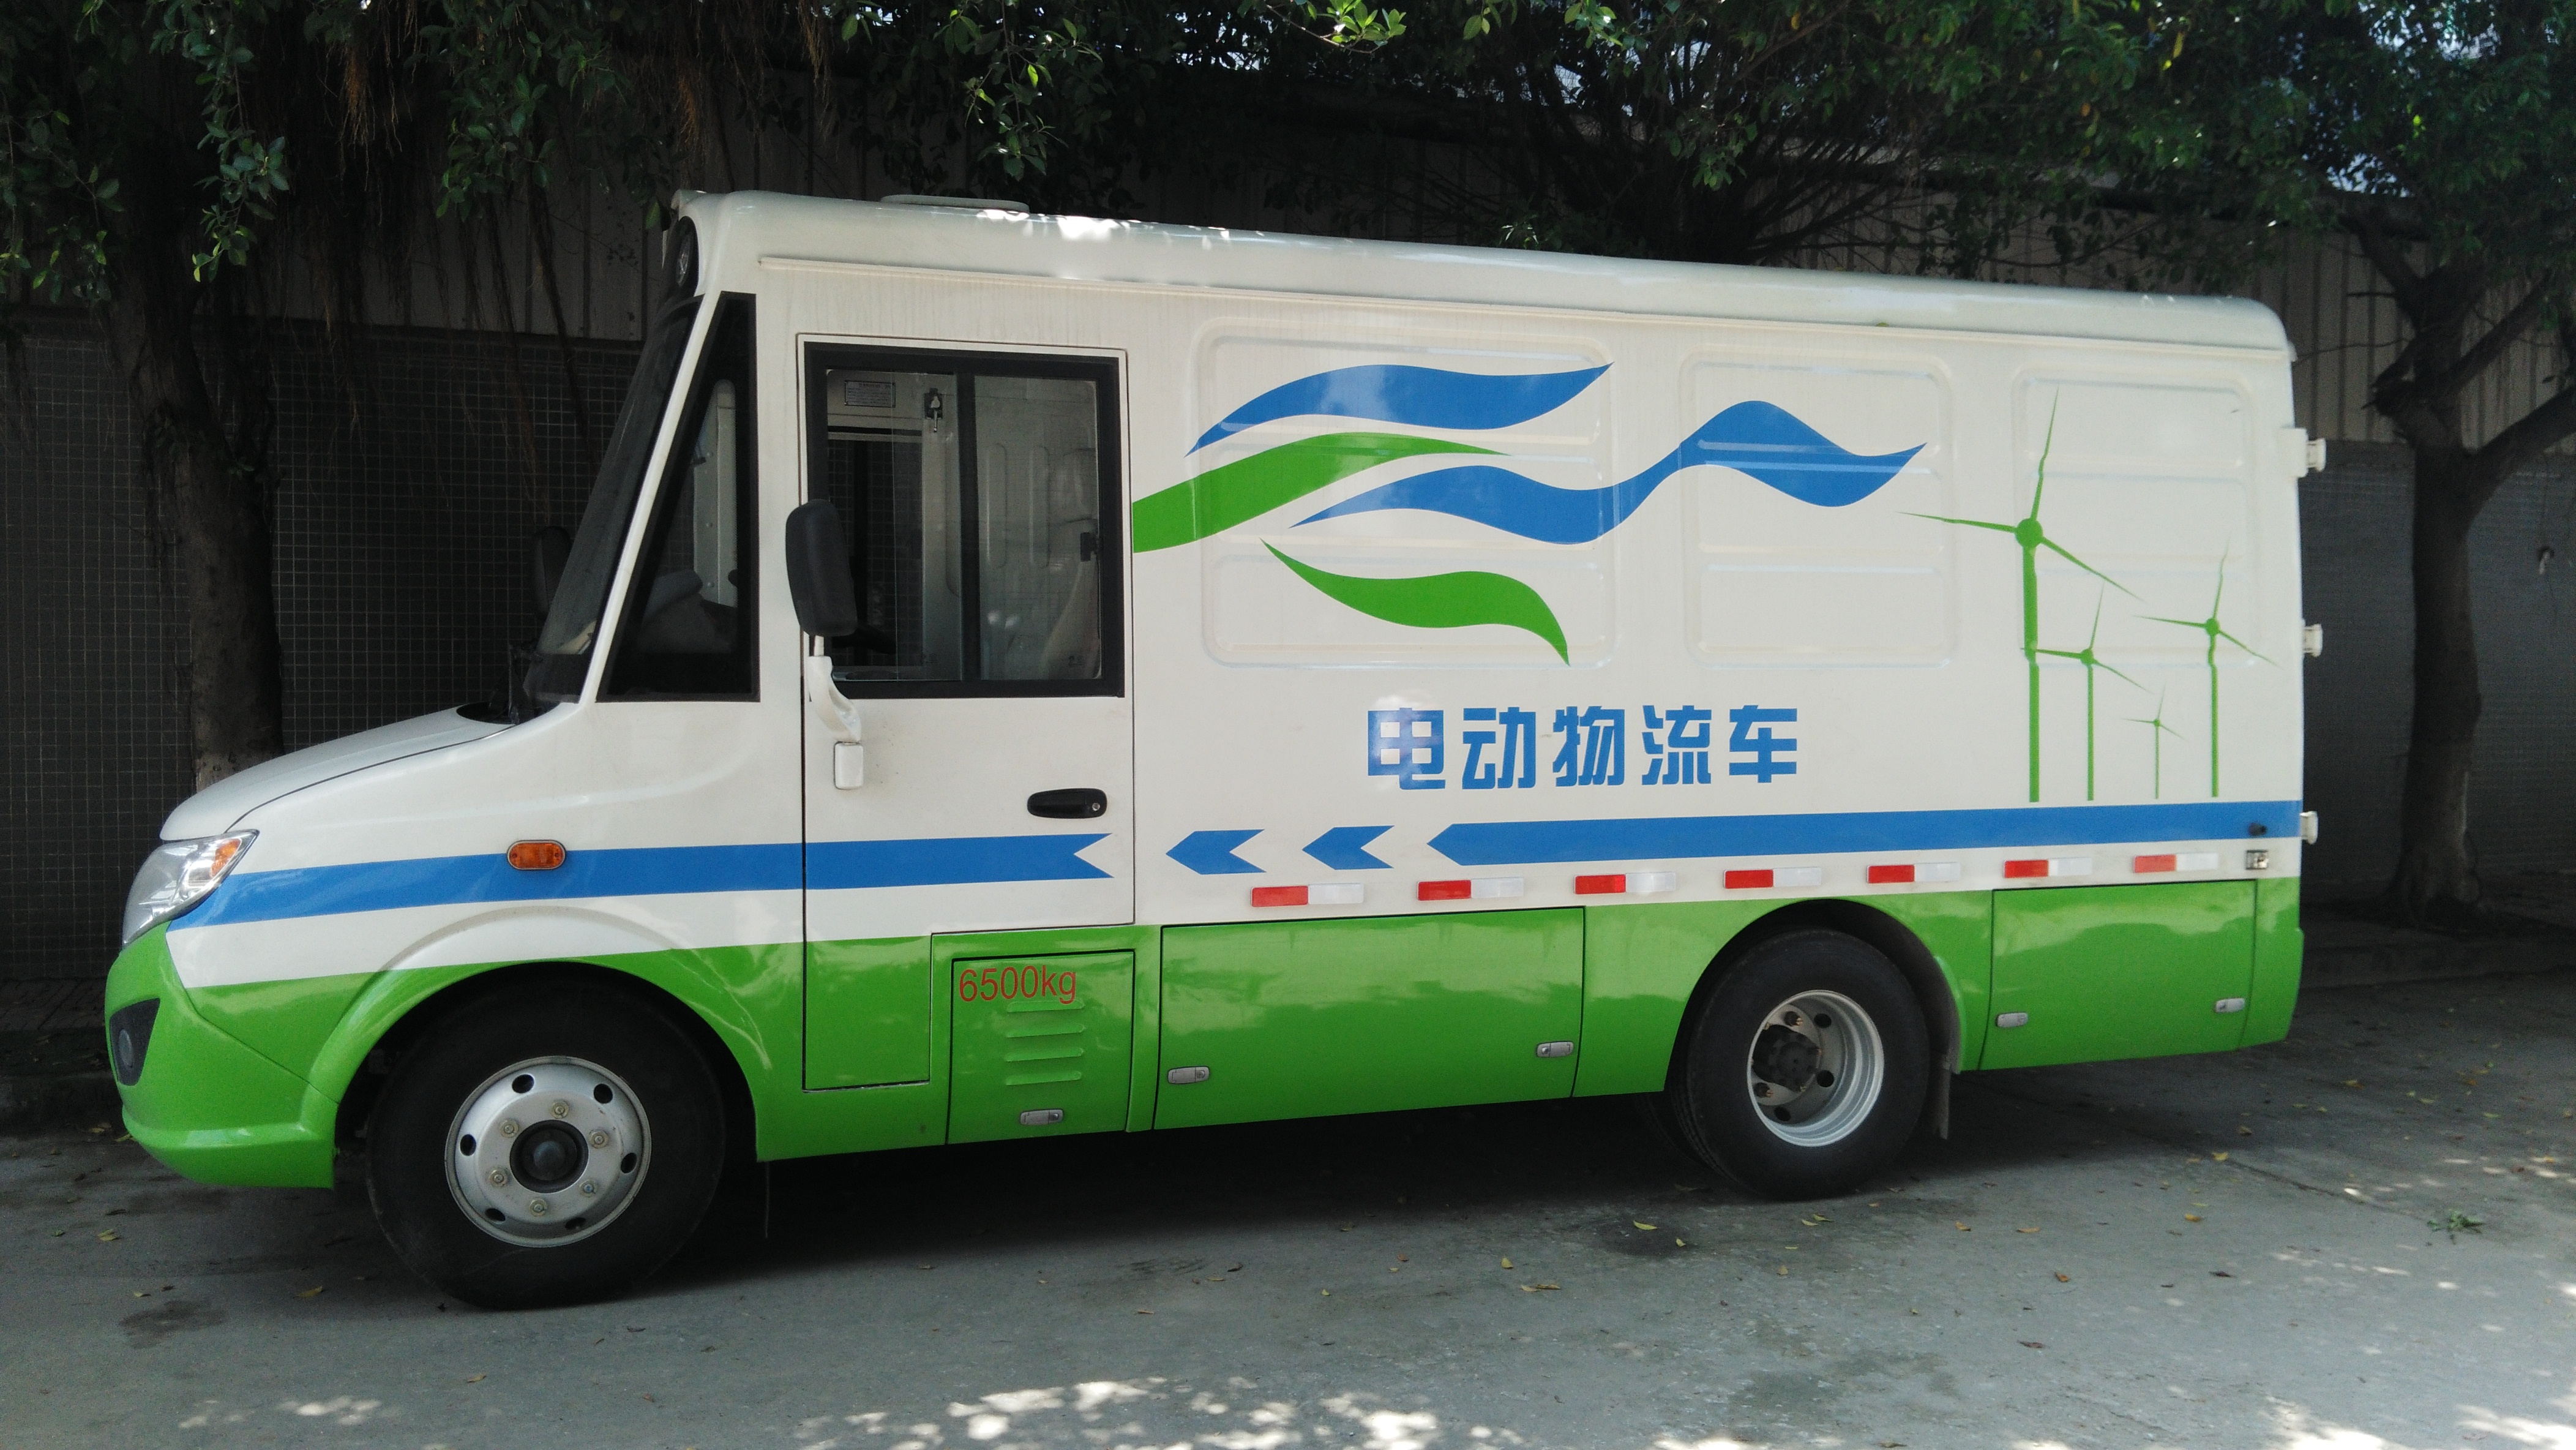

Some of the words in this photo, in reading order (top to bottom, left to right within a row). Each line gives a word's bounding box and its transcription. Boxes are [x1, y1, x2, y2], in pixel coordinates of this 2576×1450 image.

[1368, 705, 1797, 790] 电动物流车
[959, 965, 1076, 1004] 6500kg
